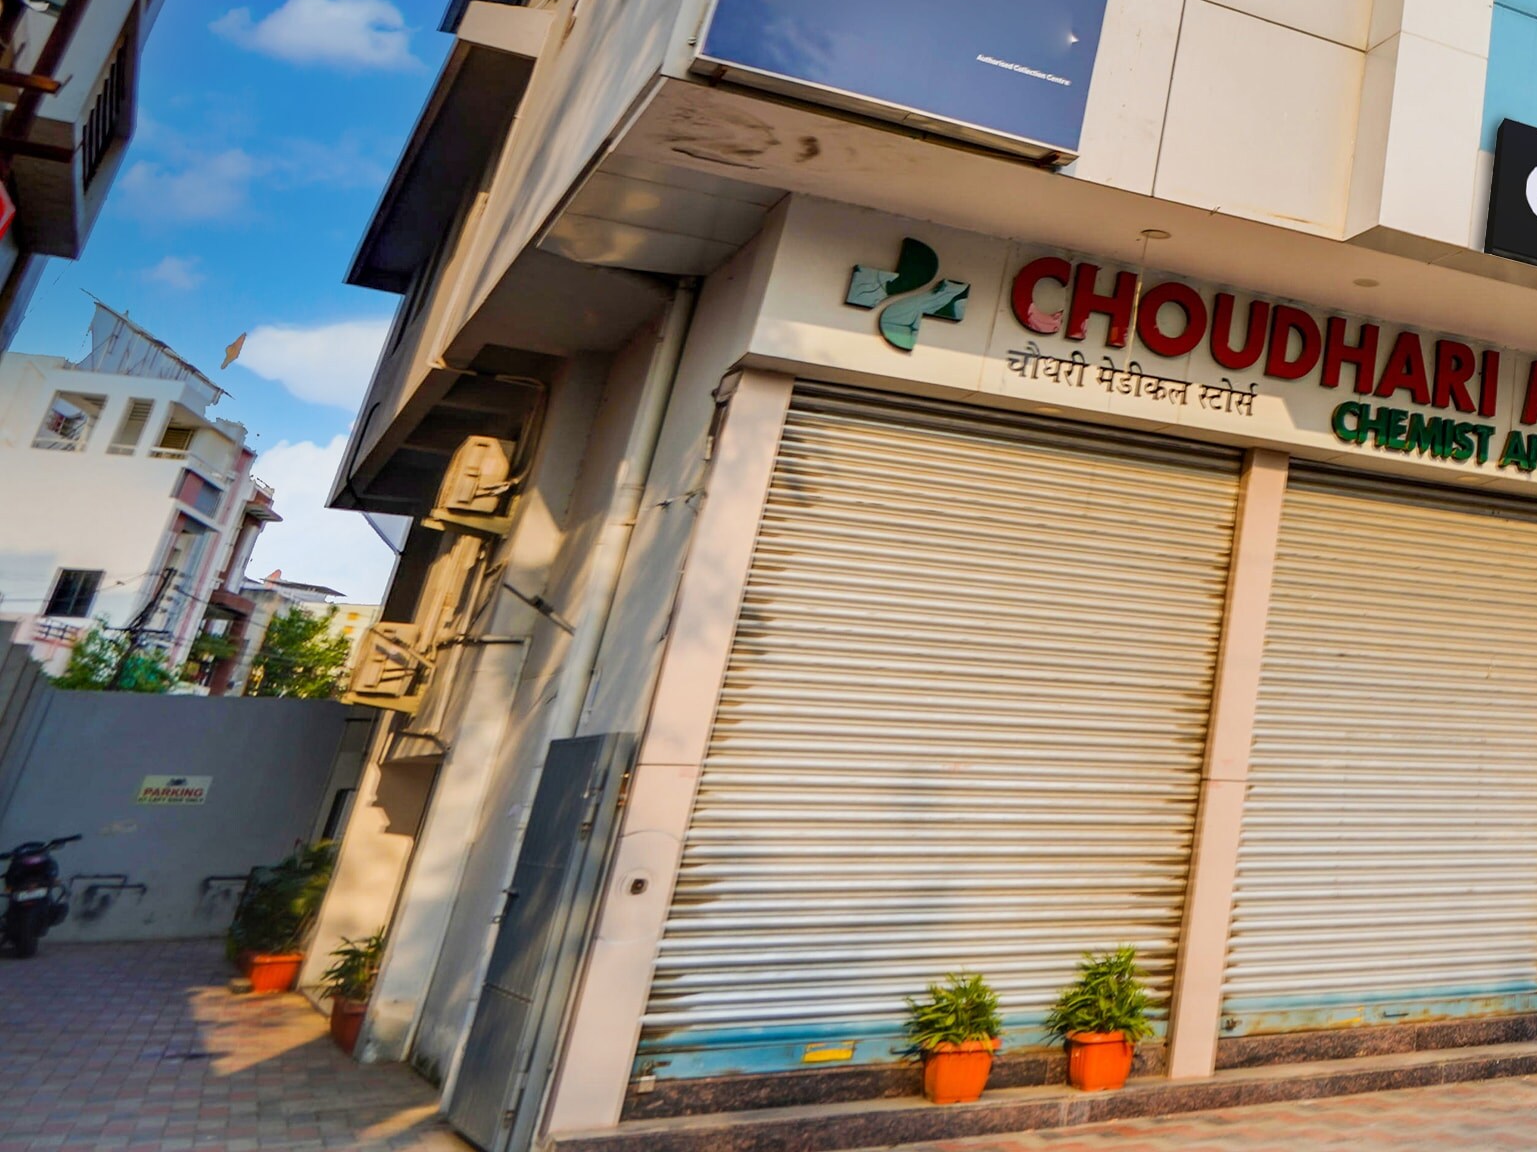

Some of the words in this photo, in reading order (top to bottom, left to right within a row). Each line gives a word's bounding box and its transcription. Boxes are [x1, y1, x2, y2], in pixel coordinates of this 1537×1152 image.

[1010, 256, 1500, 417] CHOUDHARI
[1006, 341, 1090, 387] चौधरी
[1095, 356, 1191, 406] मेडीकल
[1198, 378, 1258, 417] स्टोर्स
[1331, 400, 1494, 464] CHEMIST
[143, 787, 204, 797] PARKING
